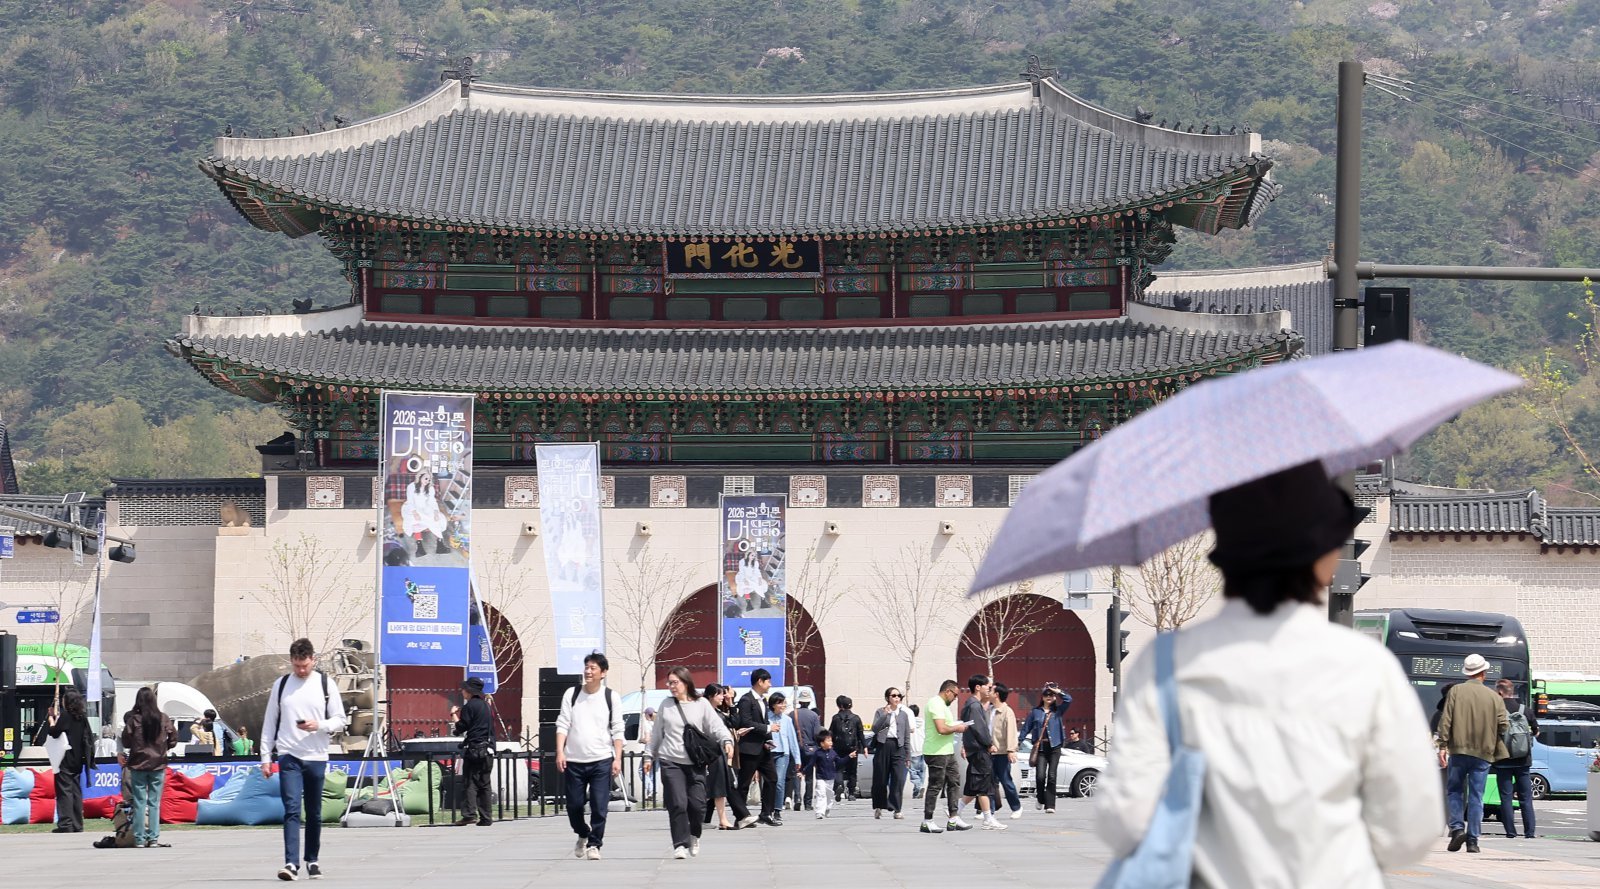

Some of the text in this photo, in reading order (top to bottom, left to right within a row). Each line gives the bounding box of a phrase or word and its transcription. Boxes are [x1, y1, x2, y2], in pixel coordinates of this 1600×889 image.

[392, 405, 466, 428] 2026 광화문
[727, 507, 745, 518] 2026
[1412, 657, 1444, 674] 7022
[94, 772, 119, 787] 2026
